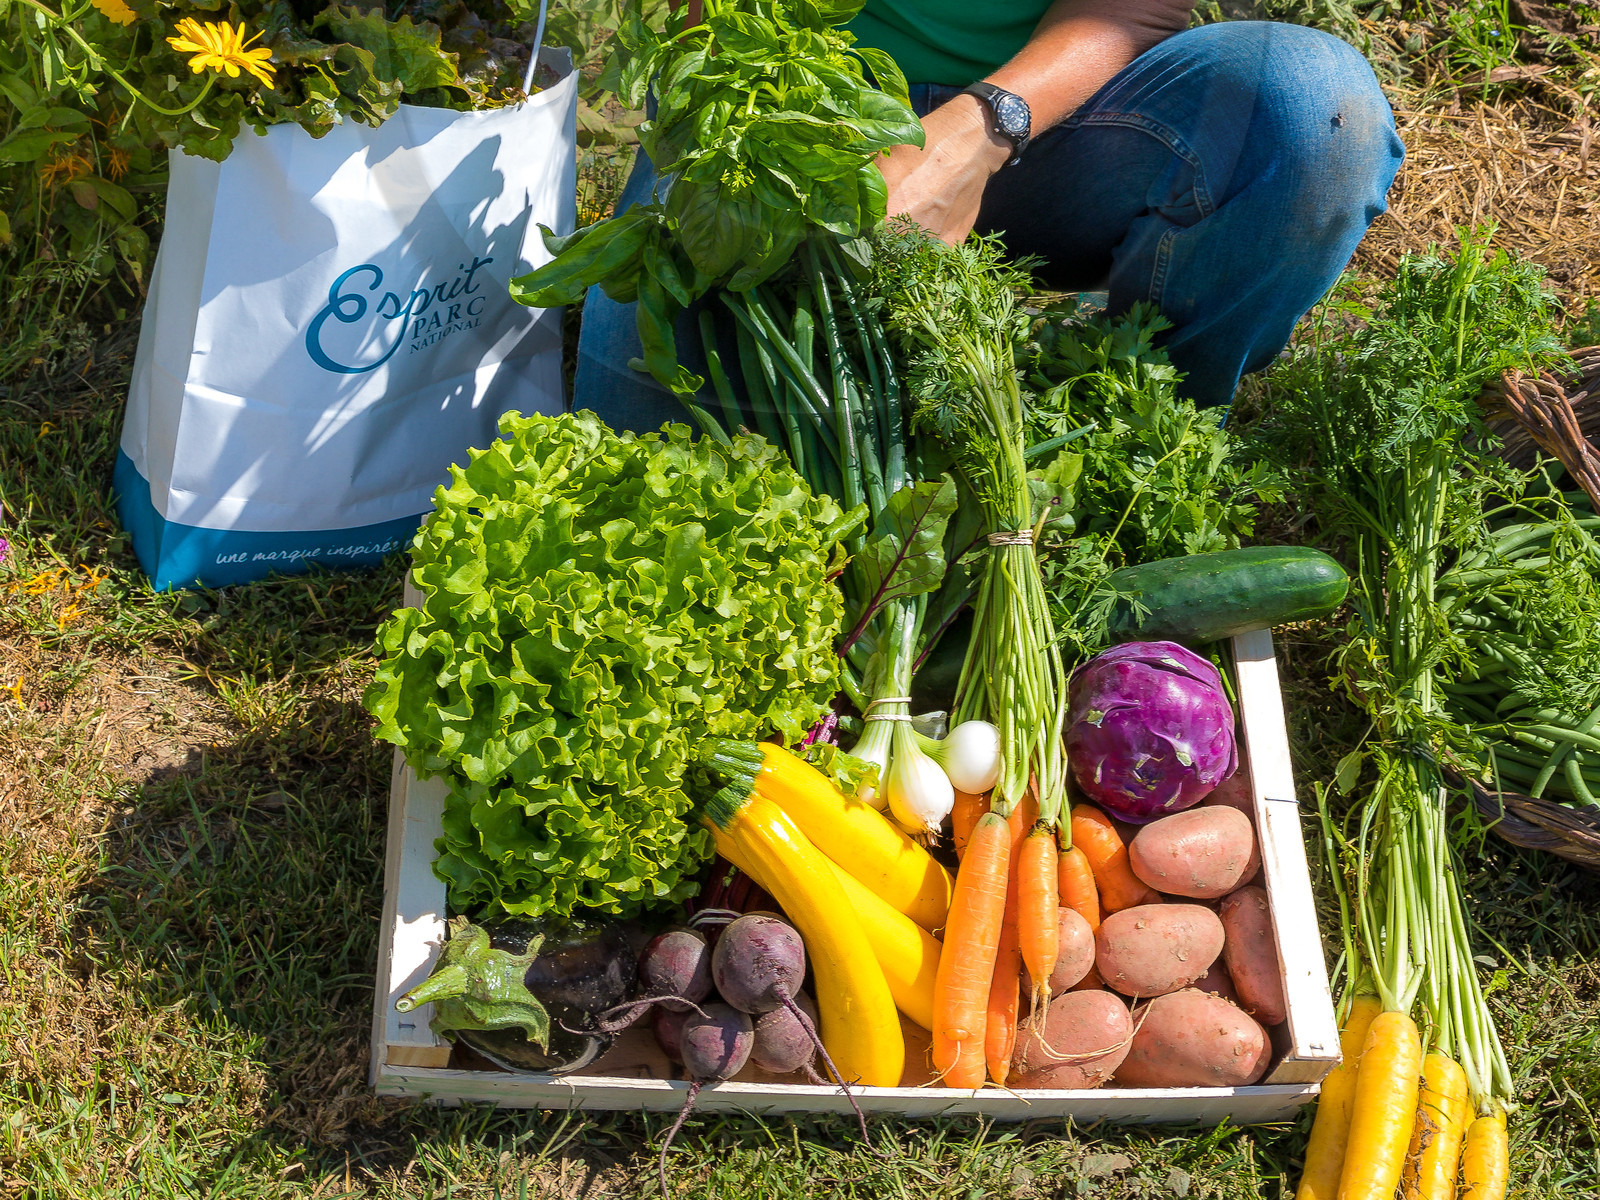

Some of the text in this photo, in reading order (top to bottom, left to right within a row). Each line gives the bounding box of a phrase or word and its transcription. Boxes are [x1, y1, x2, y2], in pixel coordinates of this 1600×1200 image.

[305, 257, 493, 374] Esprit
[409, 317, 481, 354] NATIONAL
[411, 296, 486, 340] PARC
[216, 550, 247, 564] une
[252, 547, 320, 562] marque
